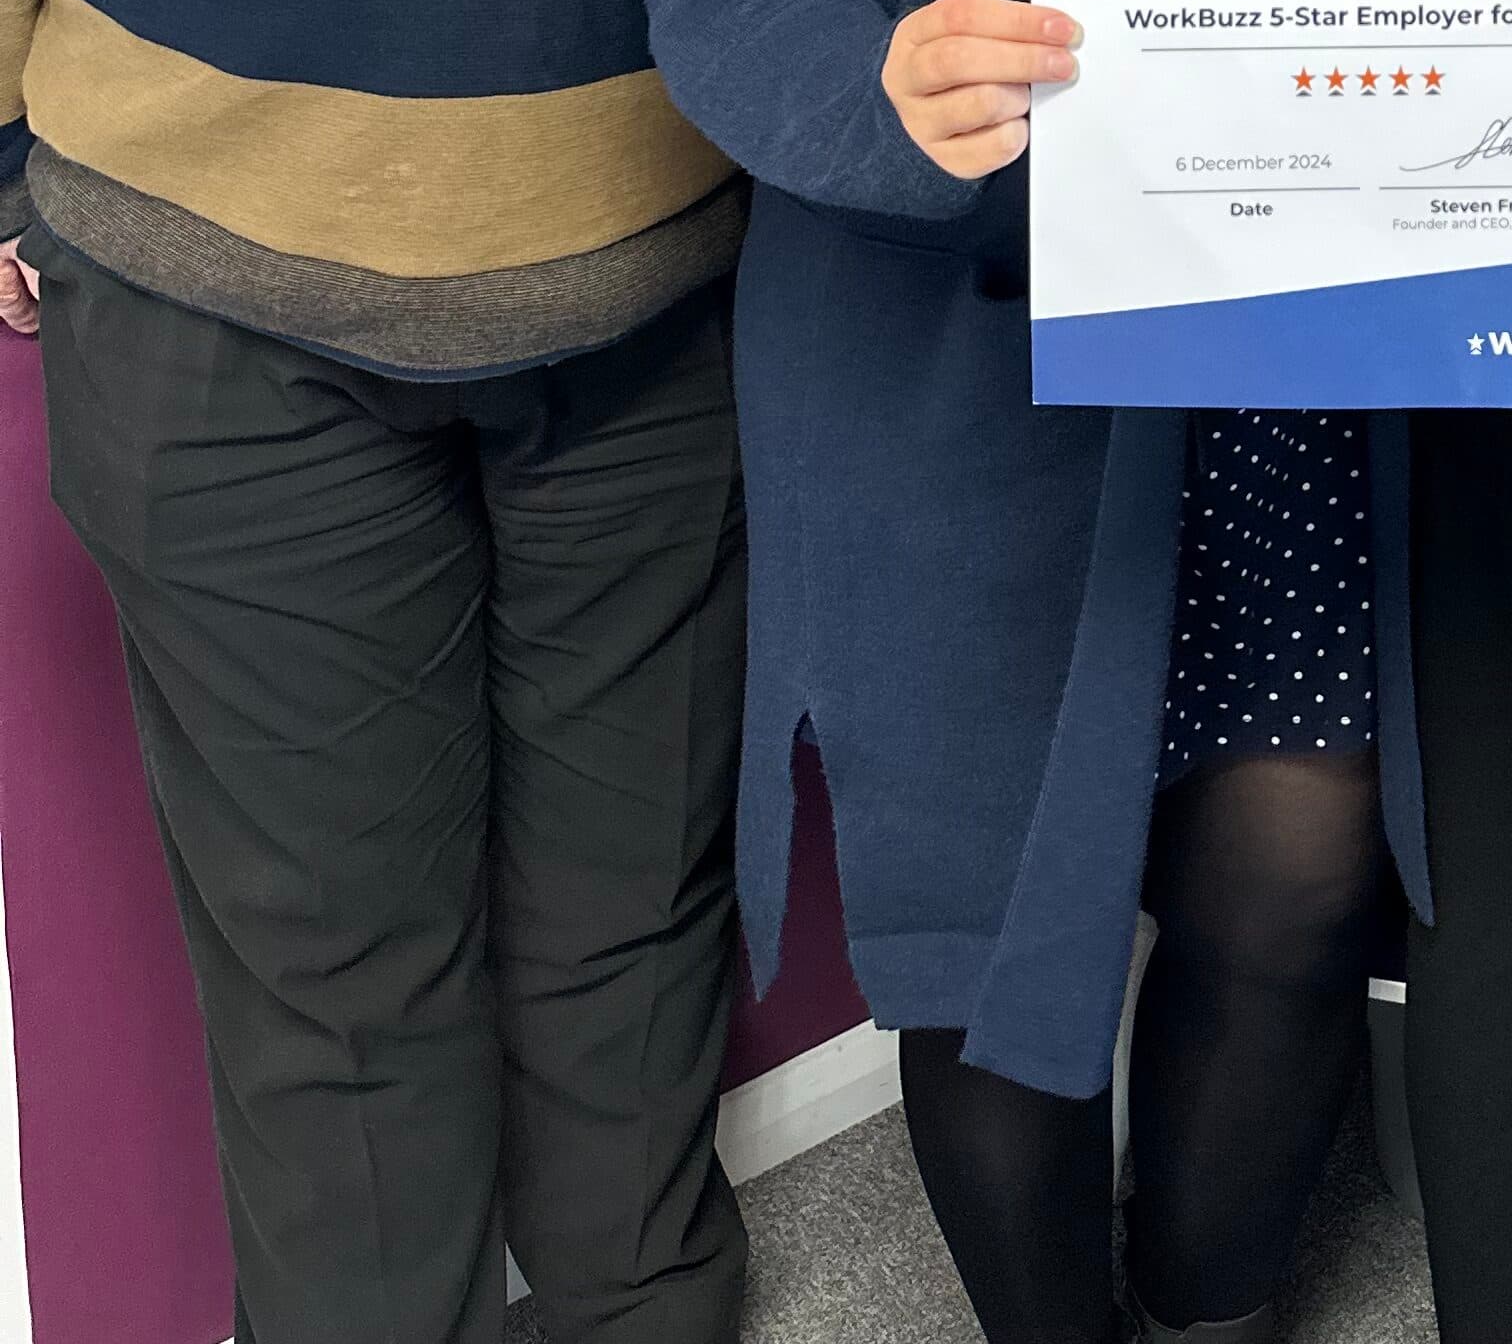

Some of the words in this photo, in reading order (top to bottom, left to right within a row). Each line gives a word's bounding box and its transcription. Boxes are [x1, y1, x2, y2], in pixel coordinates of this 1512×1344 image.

[1124, 6, 1263, 30] WorkBuzz
[1270, 5, 1349, 28] 5-Star
[1357, 4, 1483, 32] Employer
[1175, 156, 1187, 172] 6
[1191, 154, 1285, 173] December
[1288, 154, 1333, 171] 2024
[1230, 201, 1274, 217] Date
[1430, 199, 1493, 214] Steven
[1392, 217, 1449, 231] Founder
[1451, 217, 1477, 230] and
[1480, 216, 1512, 231] CEO,
